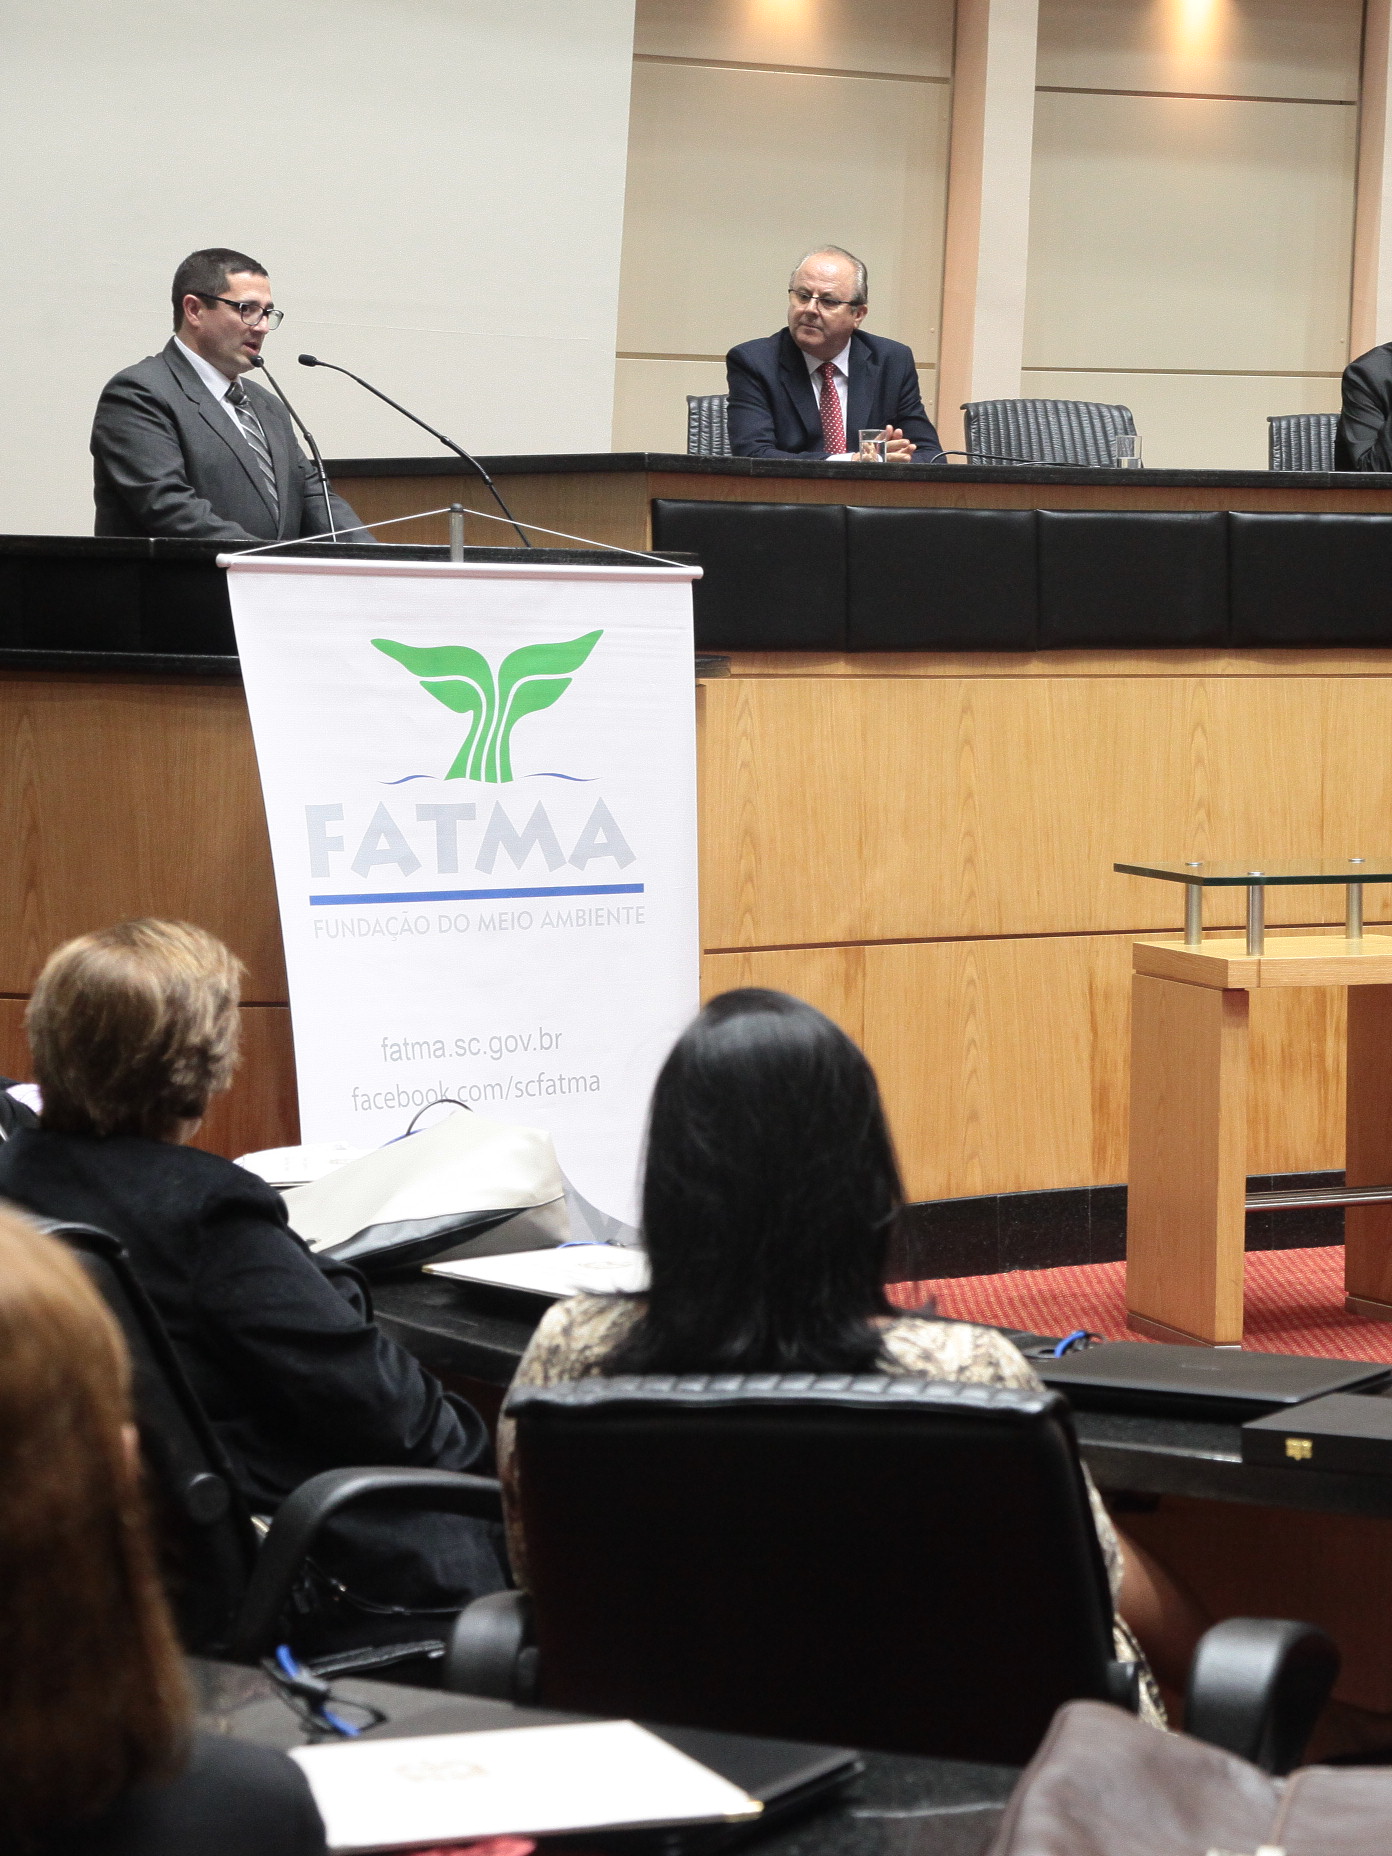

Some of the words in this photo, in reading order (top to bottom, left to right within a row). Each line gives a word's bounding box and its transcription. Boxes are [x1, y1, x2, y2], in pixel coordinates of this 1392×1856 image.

[304, 796, 637, 879] FATMA
[313, 910, 431, 942] FUNDAÇÃO
[438, 913, 471, 933] DO
[478, 910, 534, 931] MEIO
[540, 905, 646, 929] AMBIENTE
[380, 1026, 563, 1063] fatma.sc.gov.br
[351, 1071, 601, 1111] facebookcom/scfatma
